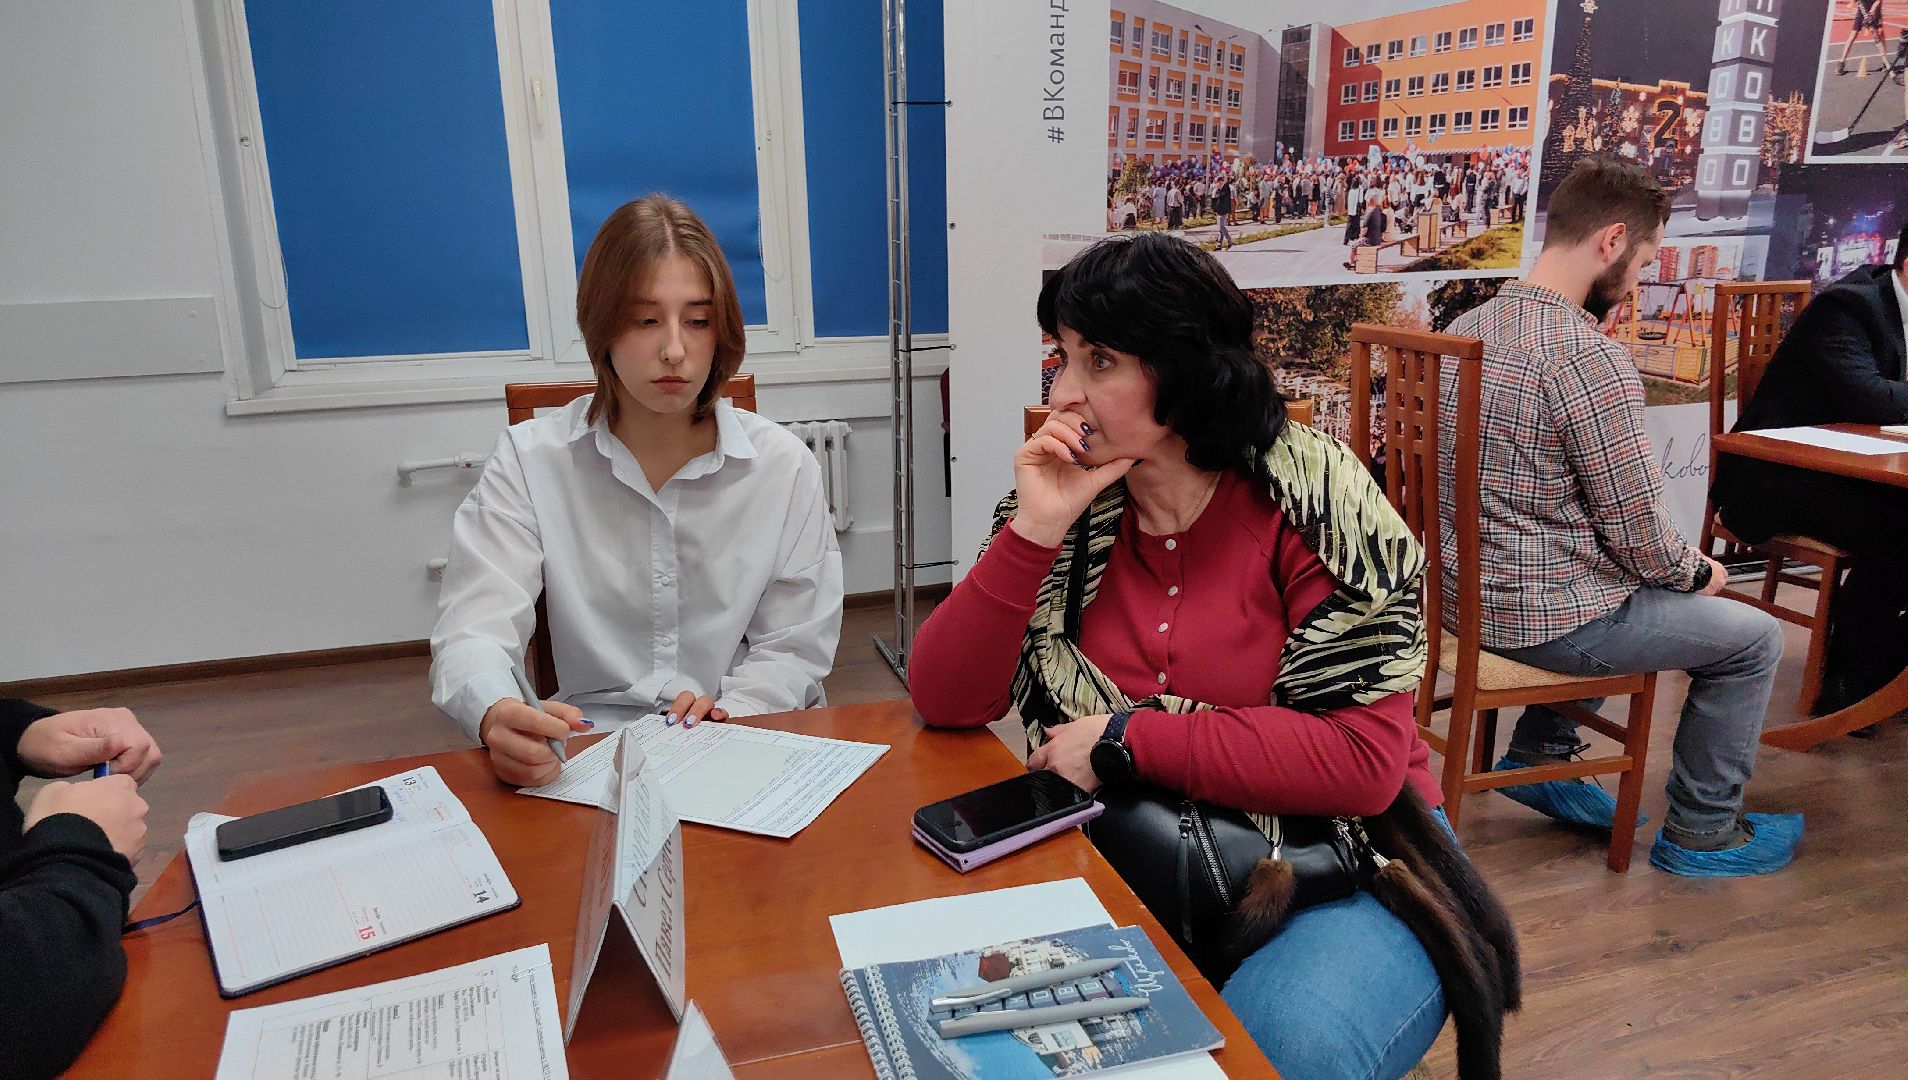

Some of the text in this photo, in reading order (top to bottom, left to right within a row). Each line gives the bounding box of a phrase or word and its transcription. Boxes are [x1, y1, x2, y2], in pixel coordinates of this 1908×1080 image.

[473, 890, 490, 904] 14
[358, 924, 377, 940] 15
[655, 896, 673, 982] Павел
